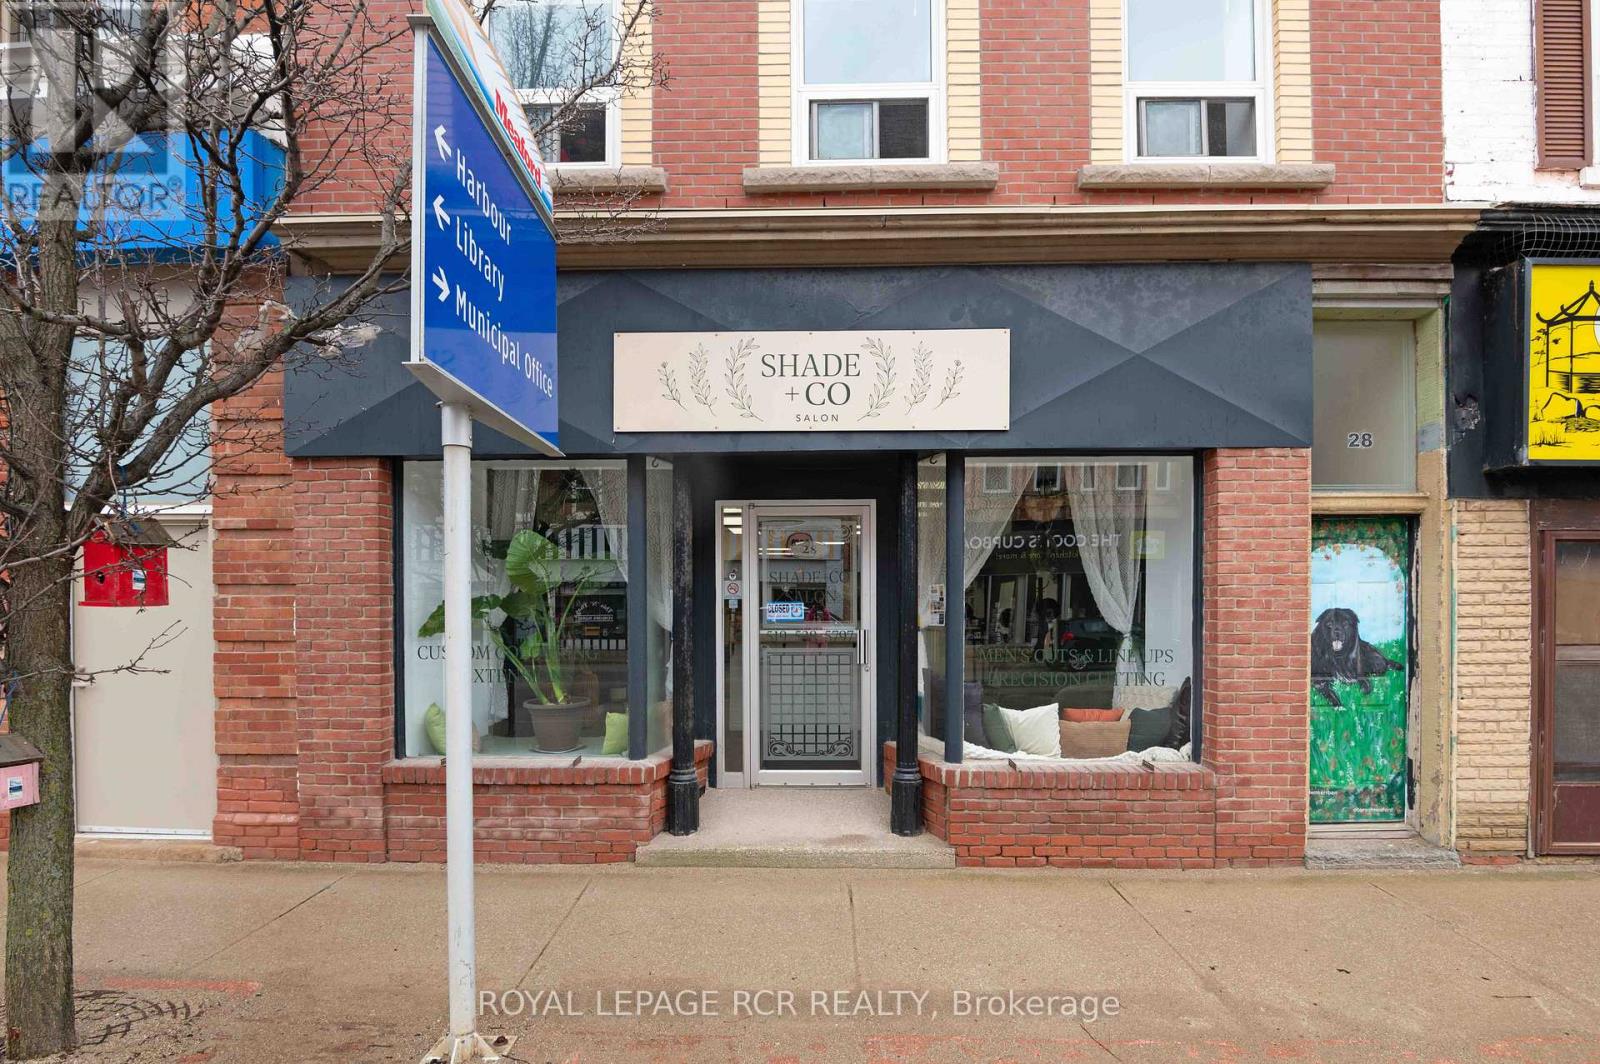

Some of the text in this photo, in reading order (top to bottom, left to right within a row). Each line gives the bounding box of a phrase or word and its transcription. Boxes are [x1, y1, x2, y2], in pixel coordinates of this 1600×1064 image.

[495, 88, 542, 190] Meaford
[457, 148, 511, 246] Harbour
[456, 216, 504, 302] Library
[456, 284, 553, 398] Municipal Office
[761, 353, 861, 378] SHADE
[805, 381, 851, 406] CO
[795, 414, 839, 422] SALON
[1347, 432, 1373, 448] 28
[768, 604, 790, 613] CLOSED
[977, 649, 1030, 664] MEN'S
[1034, 649, 1078, 664] CUTS
[1084, 649, 1095, 663] &
[1146, 649, 1174, 663] UPS
[989, 671, 1165, 687] PRECISION CUTTING
